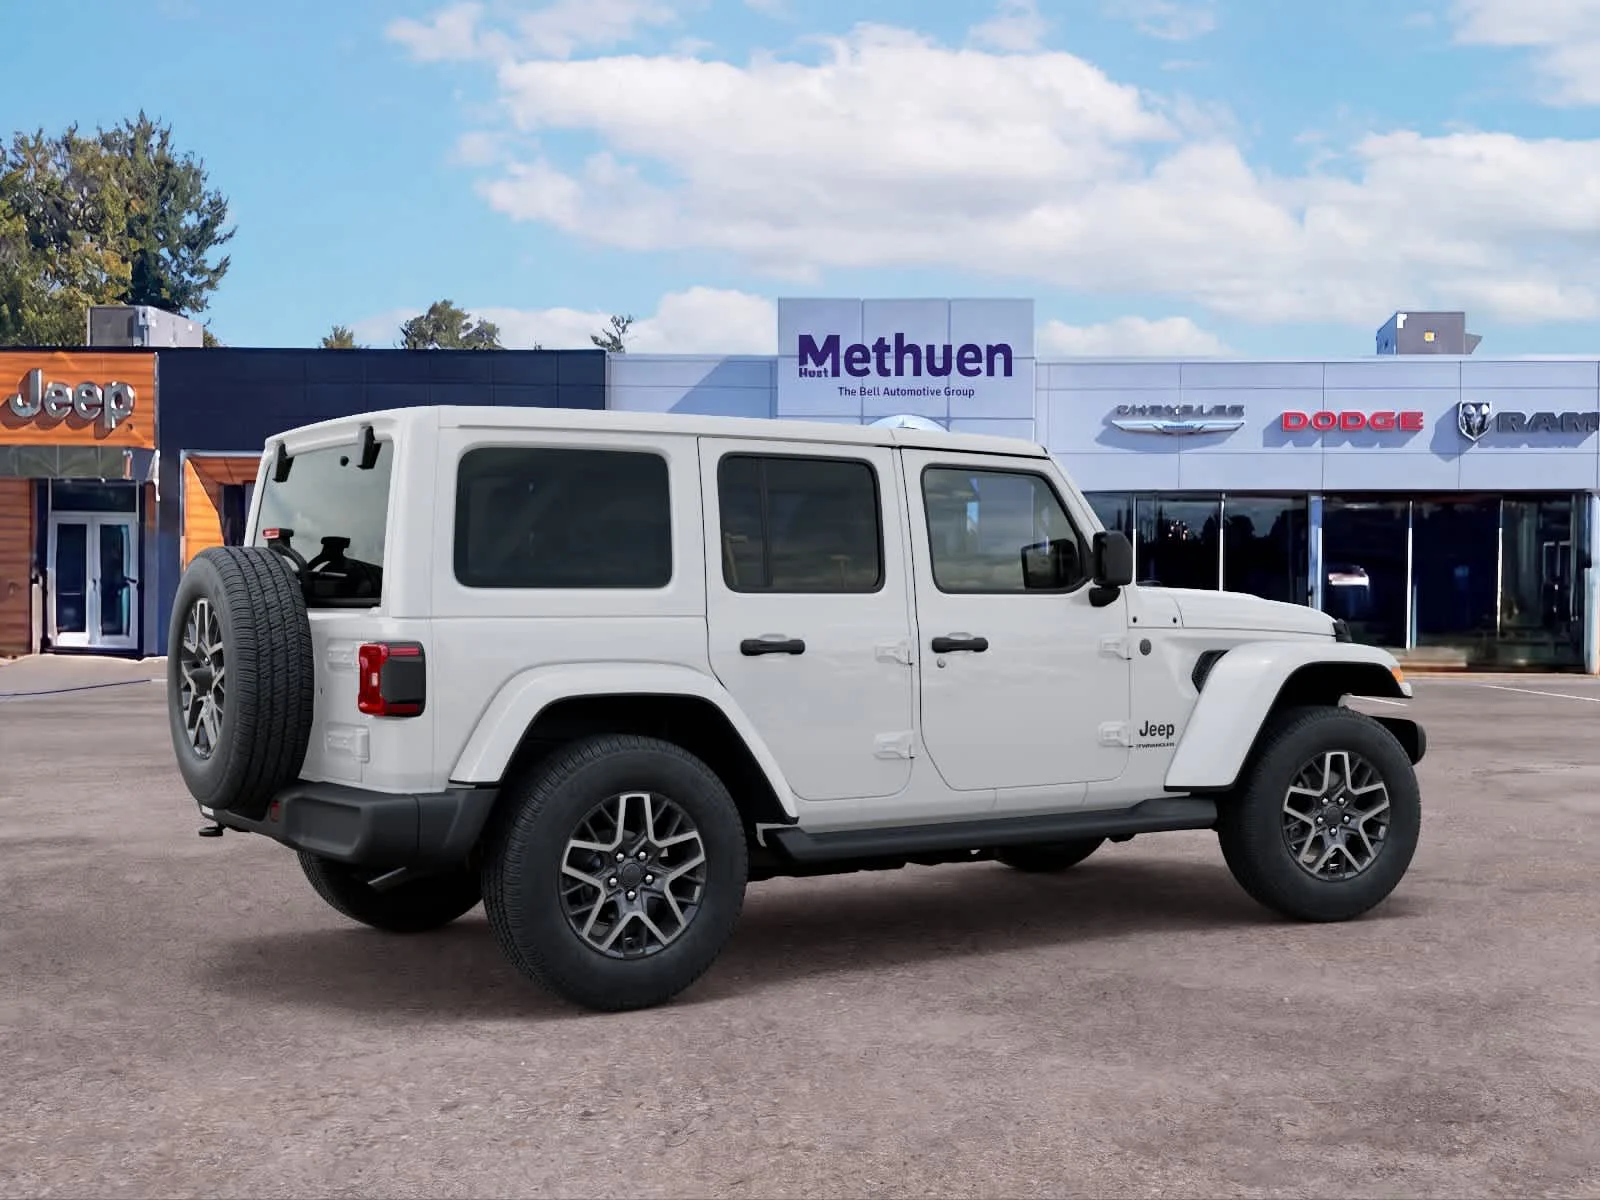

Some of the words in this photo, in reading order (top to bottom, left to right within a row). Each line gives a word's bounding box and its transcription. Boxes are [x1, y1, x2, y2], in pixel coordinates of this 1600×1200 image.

[798, 333, 1013, 378] Methuen
[9, 368, 135, 429] Jeep
[838, 386, 857, 397] The
[859, 386, 880, 397] Bell
[883, 386, 941, 397] Automotive
[944, 386, 975, 399] Group
[1282, 411, 1424, 431] DODGE
[1497, 411, 1600, 432] RAM
[1139, 720, 1175, 740] Jeep
